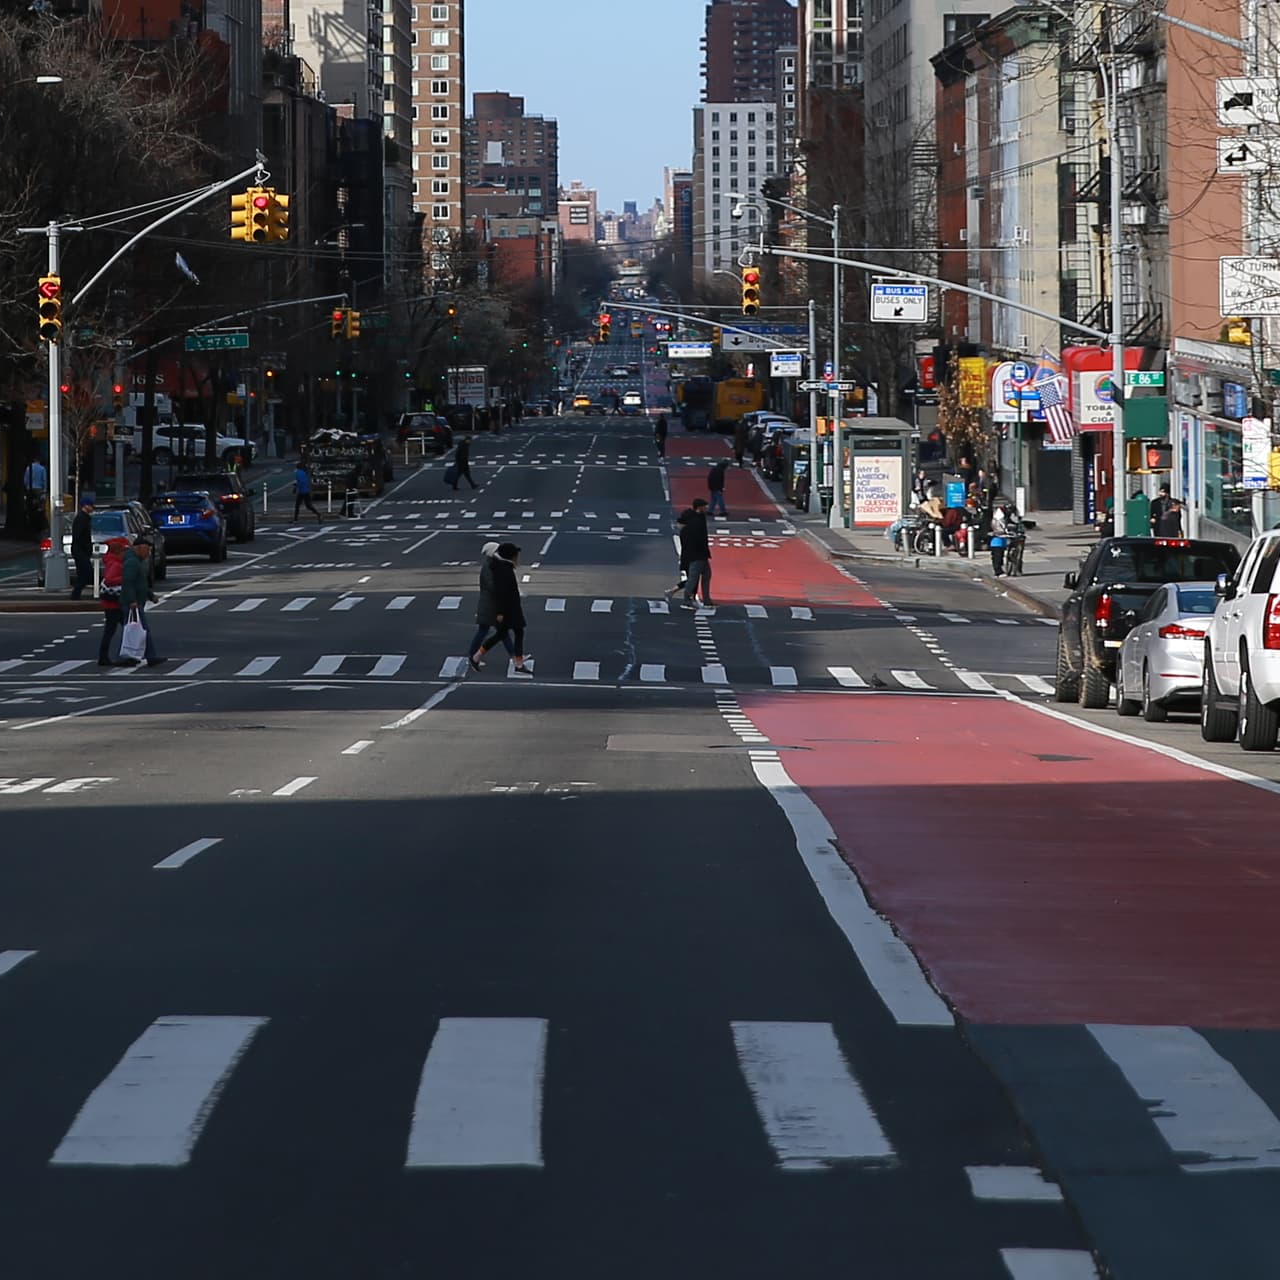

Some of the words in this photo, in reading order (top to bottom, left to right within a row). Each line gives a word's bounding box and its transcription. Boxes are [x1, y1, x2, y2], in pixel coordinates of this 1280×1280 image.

[886, 287, 902, 295] BUS
[902, 287, 925, 295] LANE
[875, 296, 900, 304] BUSES
[902, 296, 923, 305] ONLY
[1130, 373, 1136, 385] E
[1138, 373, 1151, 385] 86
